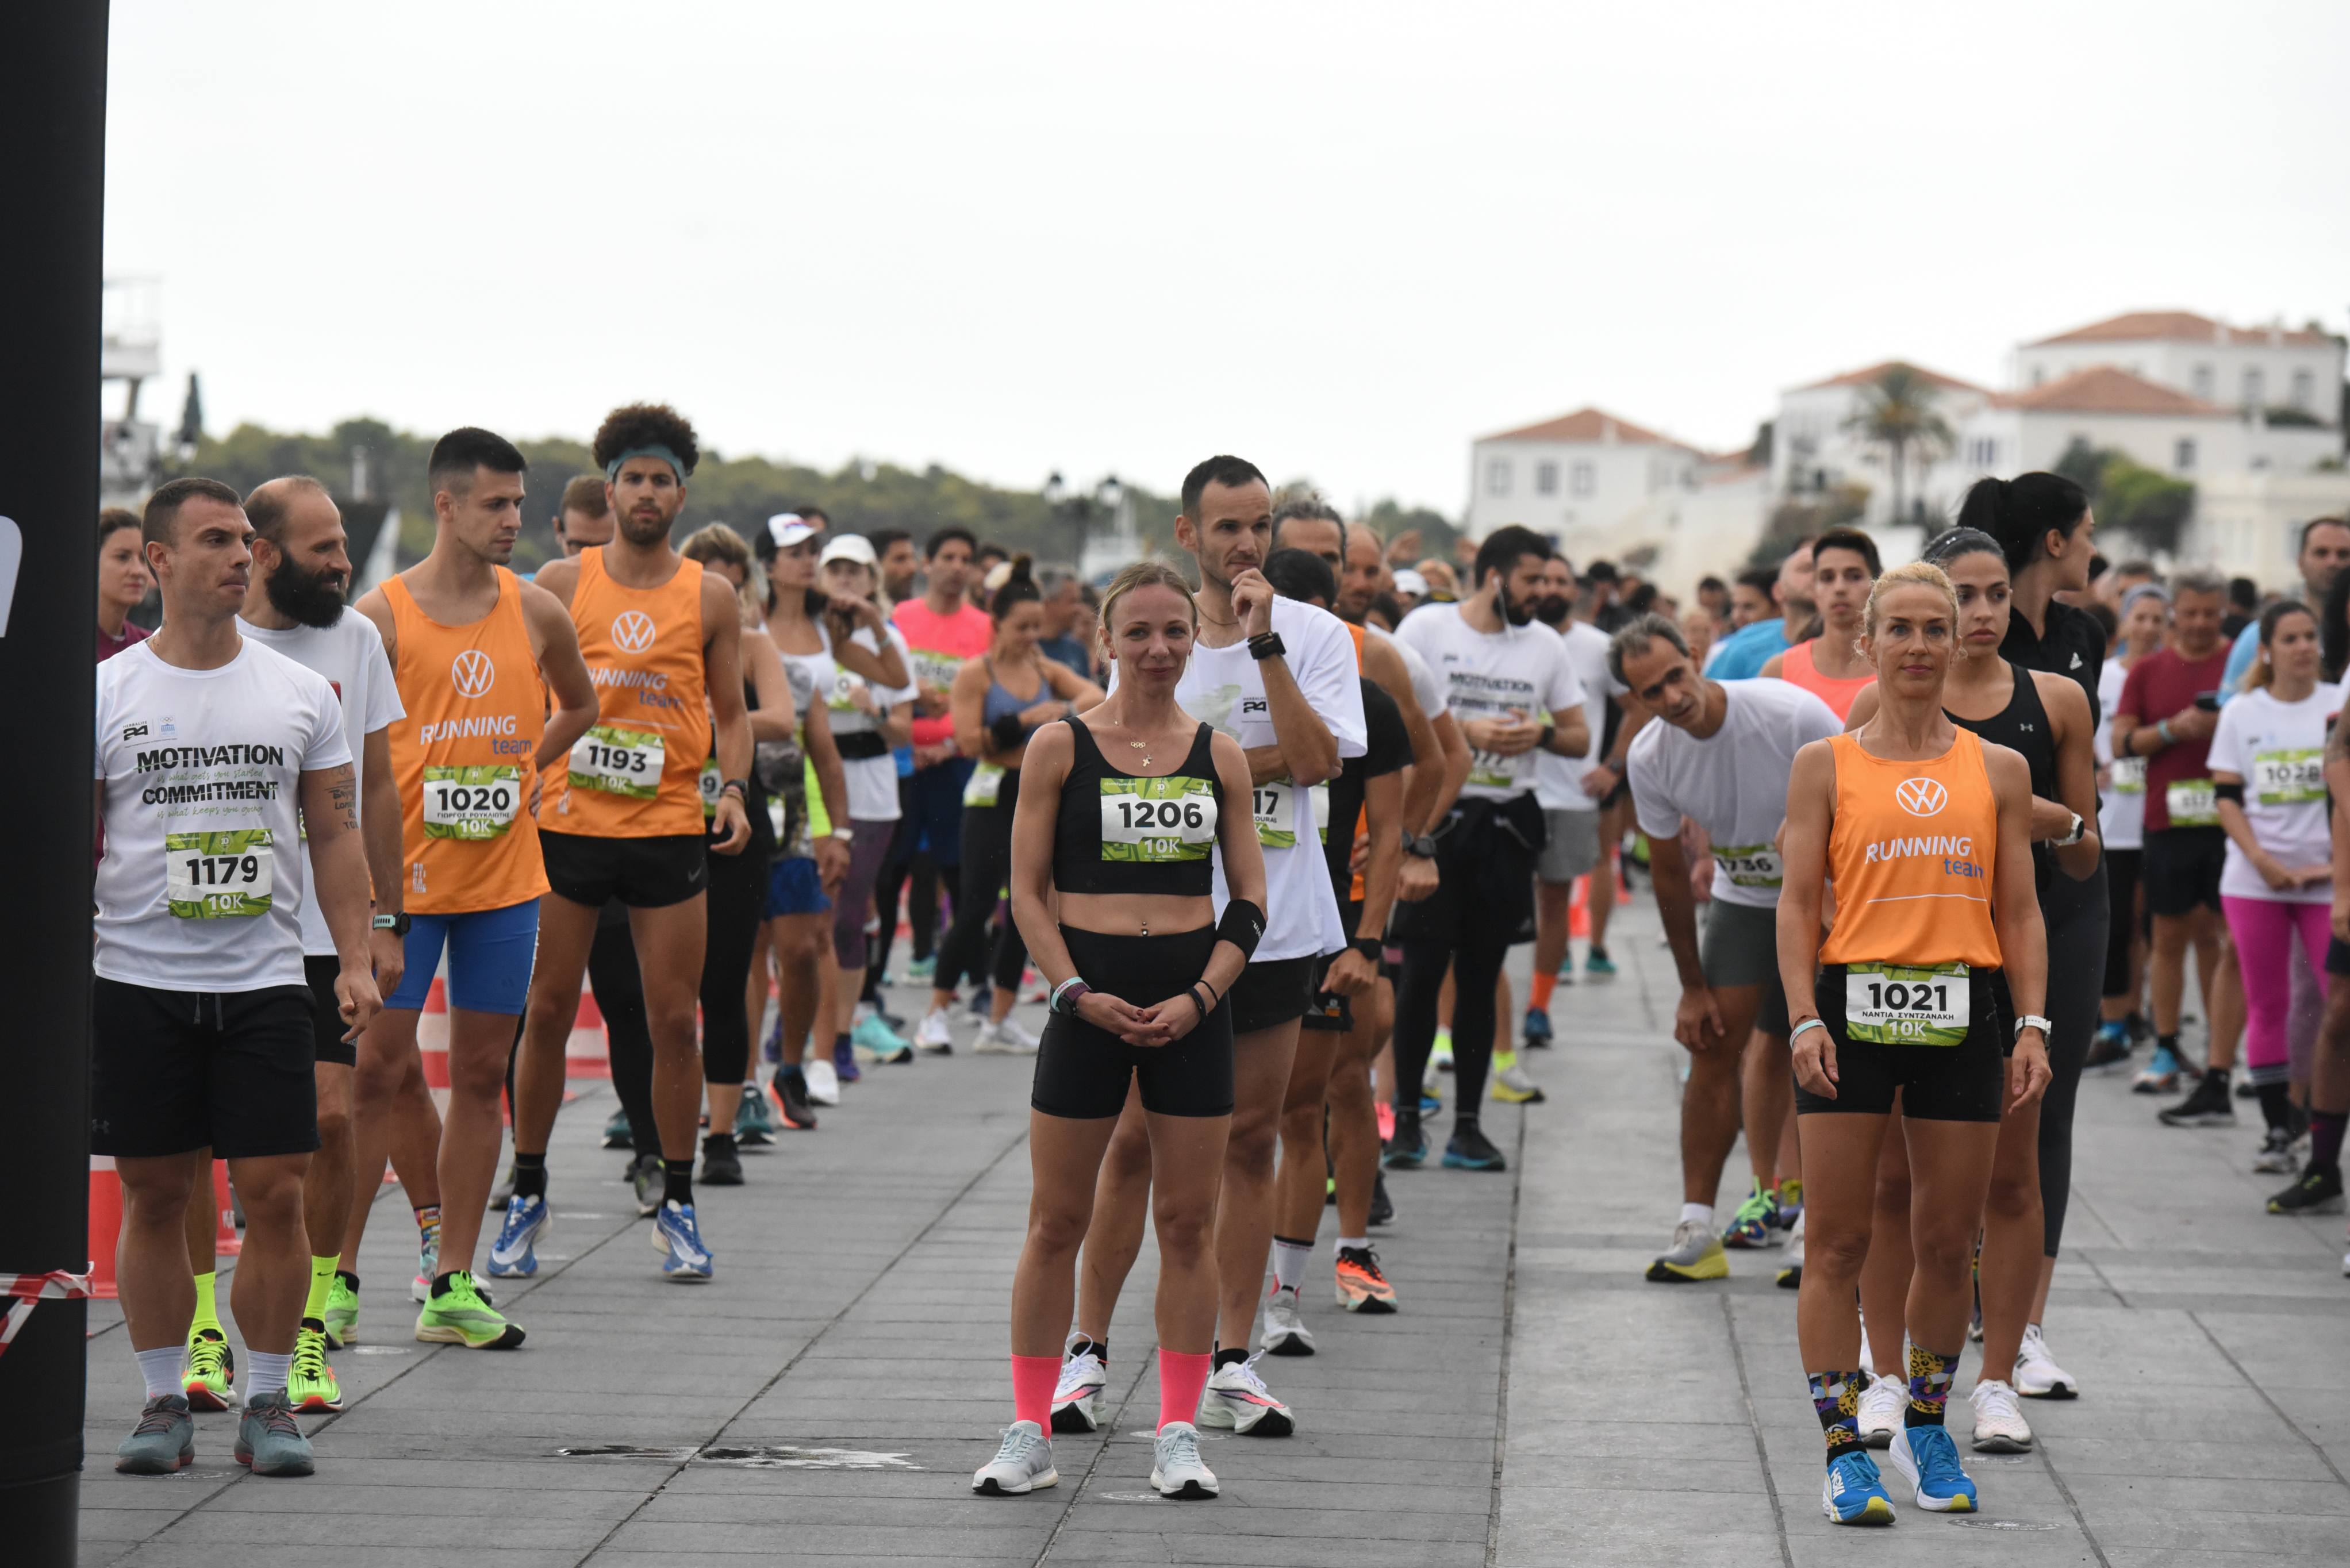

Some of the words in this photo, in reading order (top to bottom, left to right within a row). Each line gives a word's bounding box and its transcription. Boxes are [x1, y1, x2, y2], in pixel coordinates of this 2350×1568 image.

[588, 668, 669, 690] UNNING
[1243, 701, 1267, 713] 24
[123, 720, 147, 728] HERBALIFE
[420, 715, 516, 745] RUNNING
[123, 725, 148, 741] 24
[491, 738, 532, 755] team
[137, 744, 283, 774] MOTIVATION
[588, 745, 647, 772] 1193
[168, 771, 189, 781] what
[191, 773, 210, 784] gets
[214, 770, 231, 781] you
[233, 767, 266, 778] started.
[600, 775, 628, 791] 10K
[142, 781, 279, 805] COMMITMENT
[437, 787, 510, 811] 1020
[157, 810, 165, 818] is
[168, 807, 189, 817] what
[193, 805, 219, 816] keeps
[222, 805, 239, 814] you
[241, 805, 264, 816] going
[1118, 801, 1203, 828] 1206
[460, 819, 491, 833] 10K
[1145, 838, 1180, 854] 10K
[1865, 836, 1972, 864] RUNNING
[186, 855, 258, 886] 1179
[208, 894, 244, 911] 10K
[1868, 983, 1947, 1012] 1021
[1898, 1012, 1955, 1020] ΣΥΝΤΖΑΝΑΚΗ
[1889, 1020, 1926, 1037] 10K
